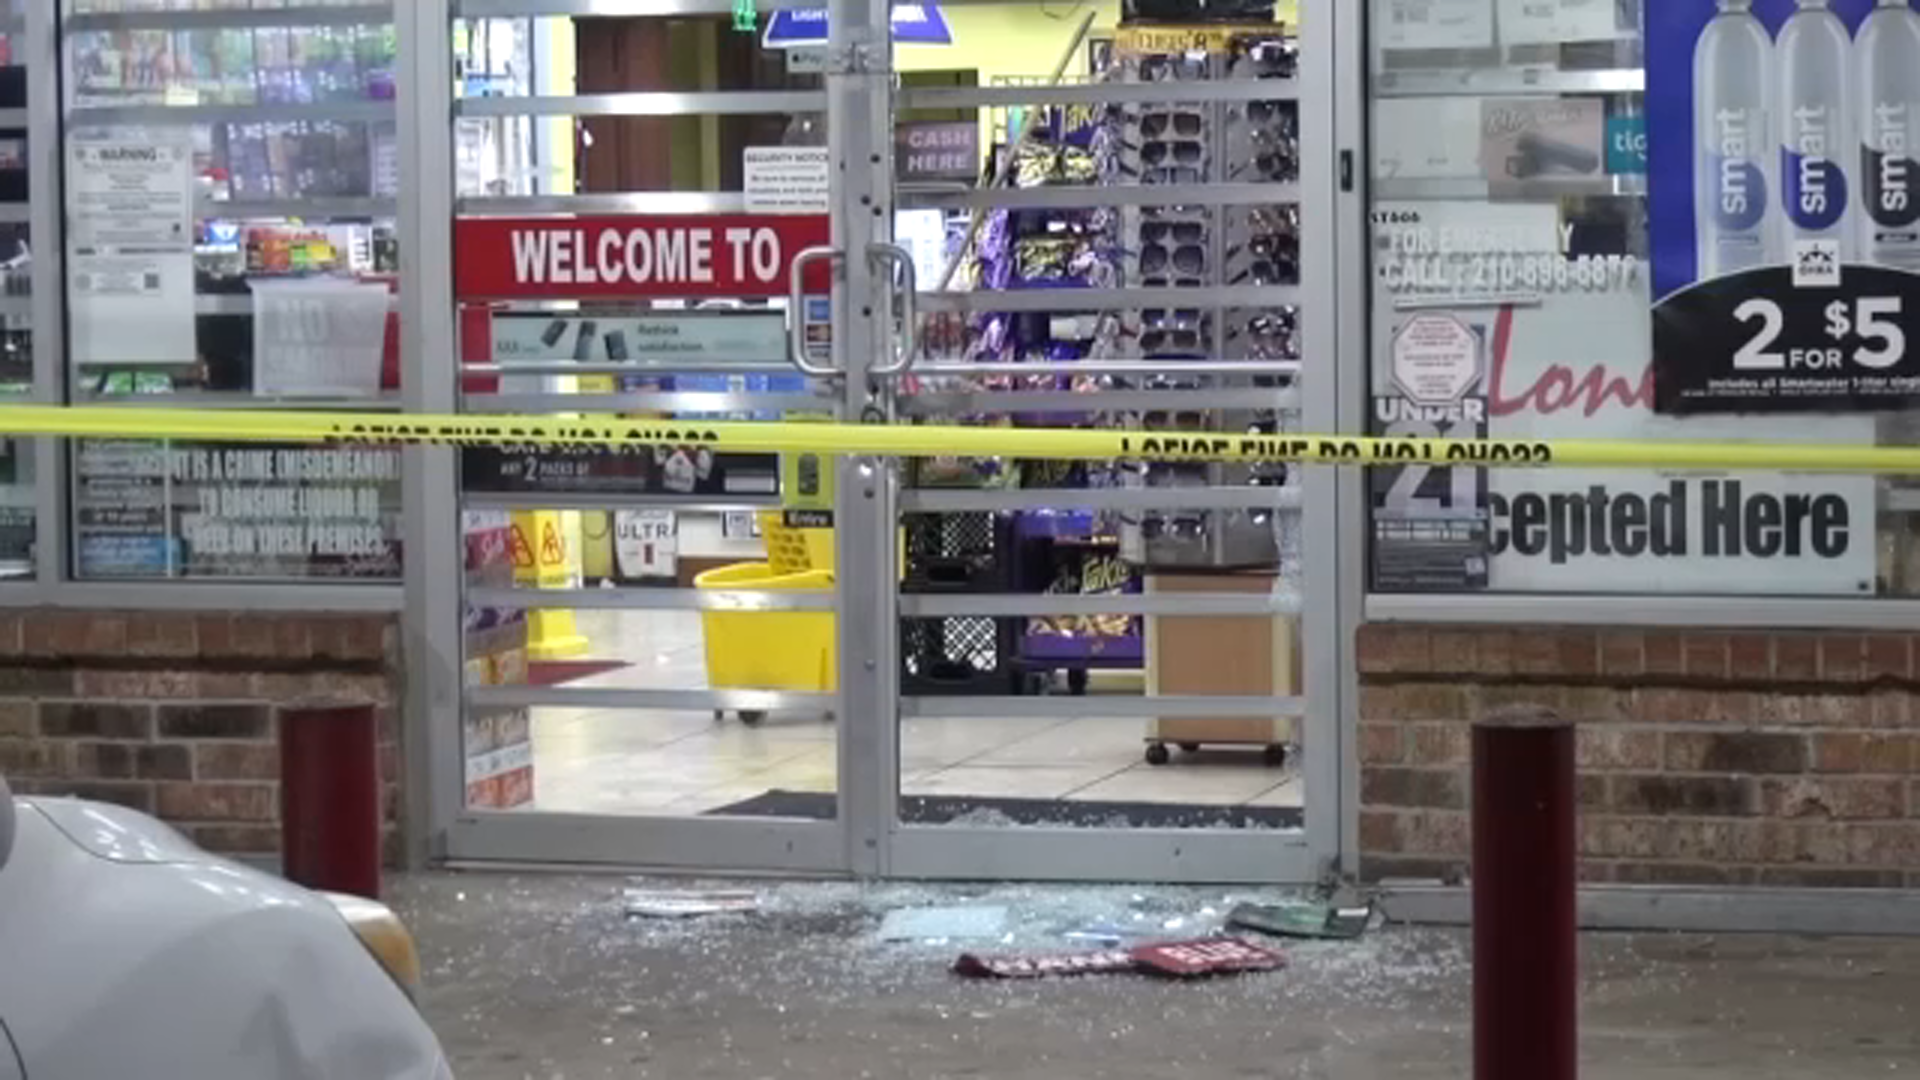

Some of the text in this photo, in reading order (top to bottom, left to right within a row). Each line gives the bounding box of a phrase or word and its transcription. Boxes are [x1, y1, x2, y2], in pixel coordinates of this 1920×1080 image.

[908, 130, 971, 147] CASH
[1797, 104, 1825, 215] smart
[1878, 101, 1907, 212] smart
[907, 154, 969, 171] HERE
[1717, 106, 1746, 215] smart
[512, 227, 781, 283] WELCOME TO
[1390, 226, 1432, 253] FOR
[1386, 257, 1447, 287] CALL
[638, 324, 679, 335] Rethink
[1733, 297, 1906, 369] 2 FOR $5
[524, 456, 537, 481] 2
[1702, 479, 1849, 558] Here
